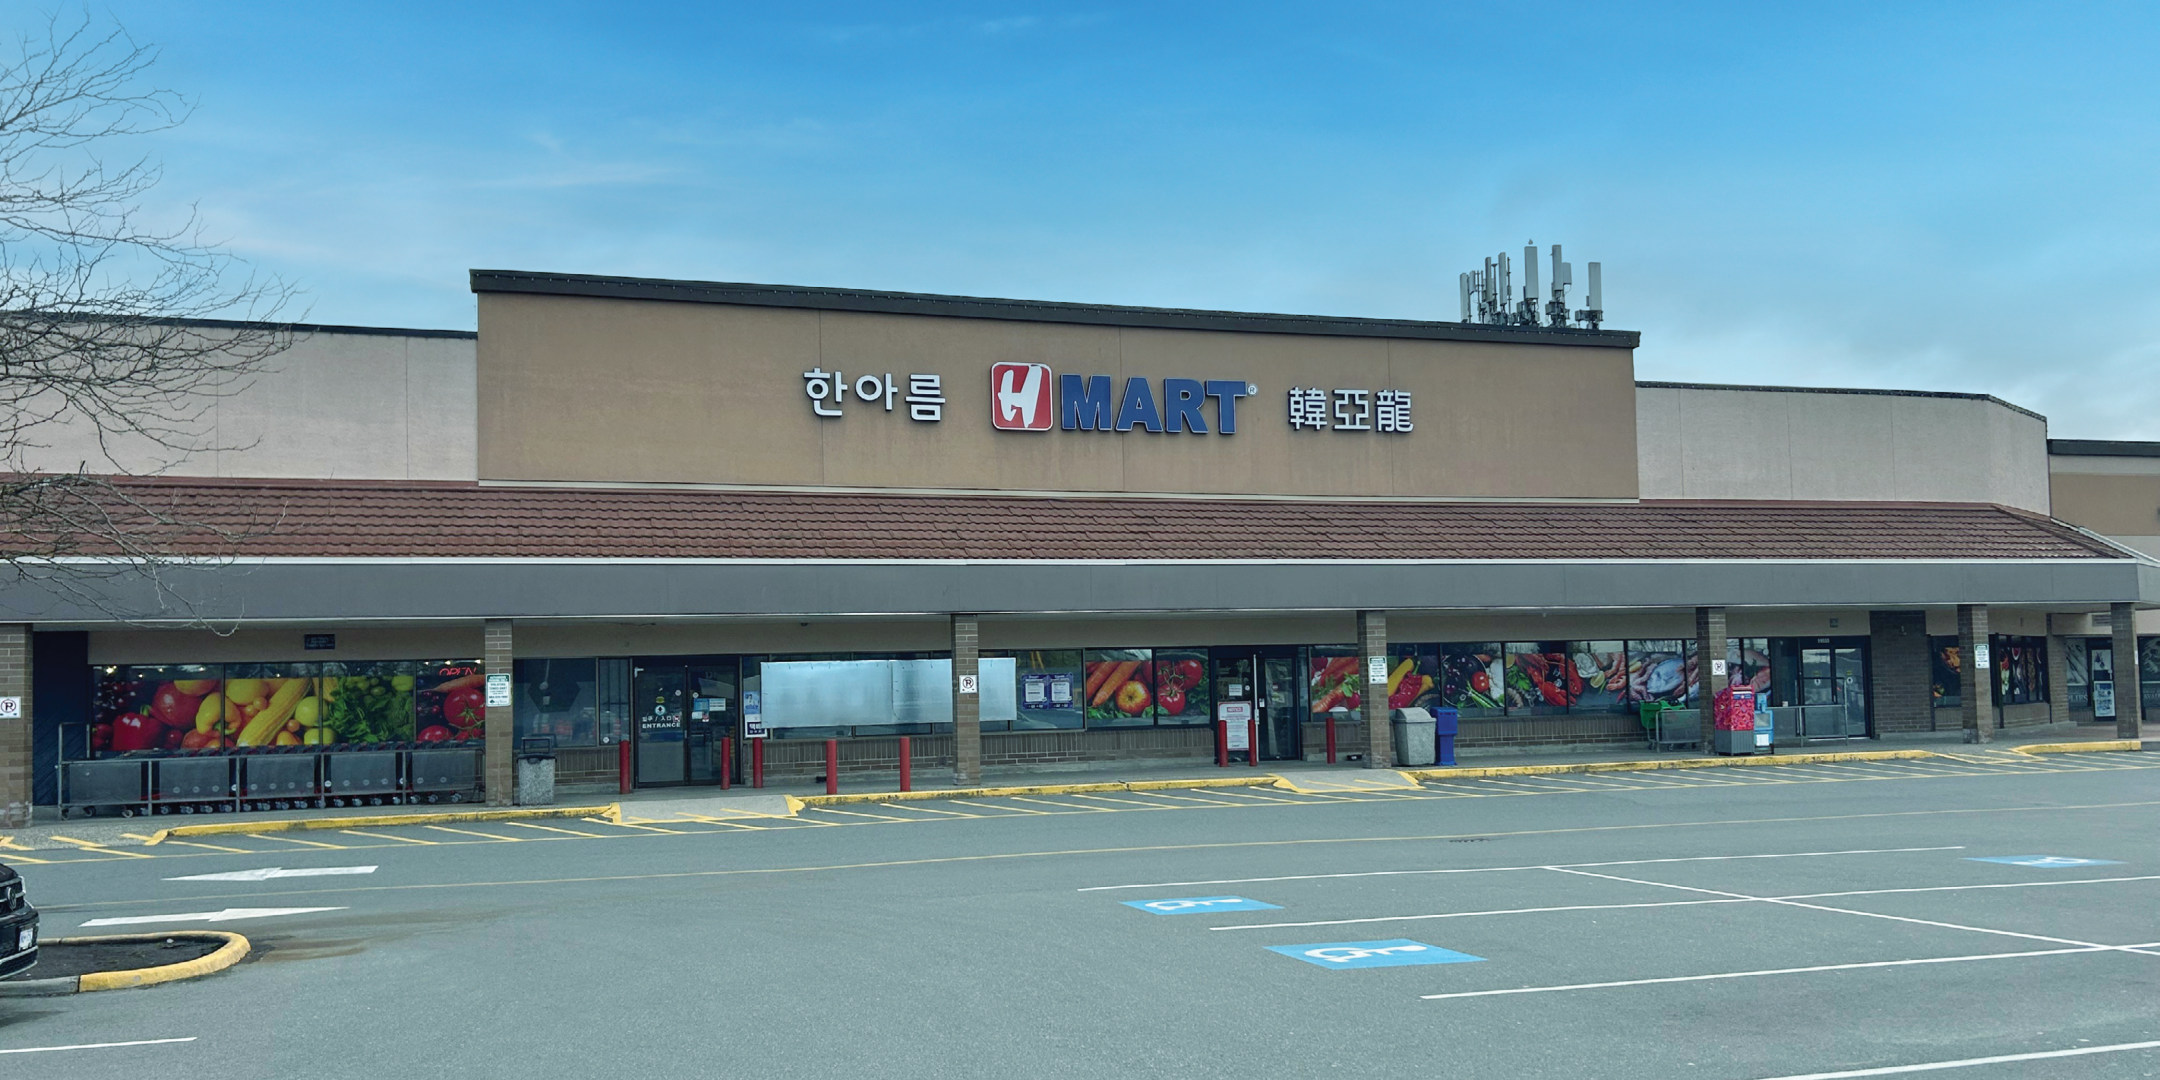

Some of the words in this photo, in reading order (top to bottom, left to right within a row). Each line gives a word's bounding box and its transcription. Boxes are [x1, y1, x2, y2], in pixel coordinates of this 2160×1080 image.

[803, 367, 946, 421] 한아름
[998, 365, 1042, 428] H
[1060, 374, 1248, 434] MART
[1288, 386, 1414, 433] 韓亞龍
